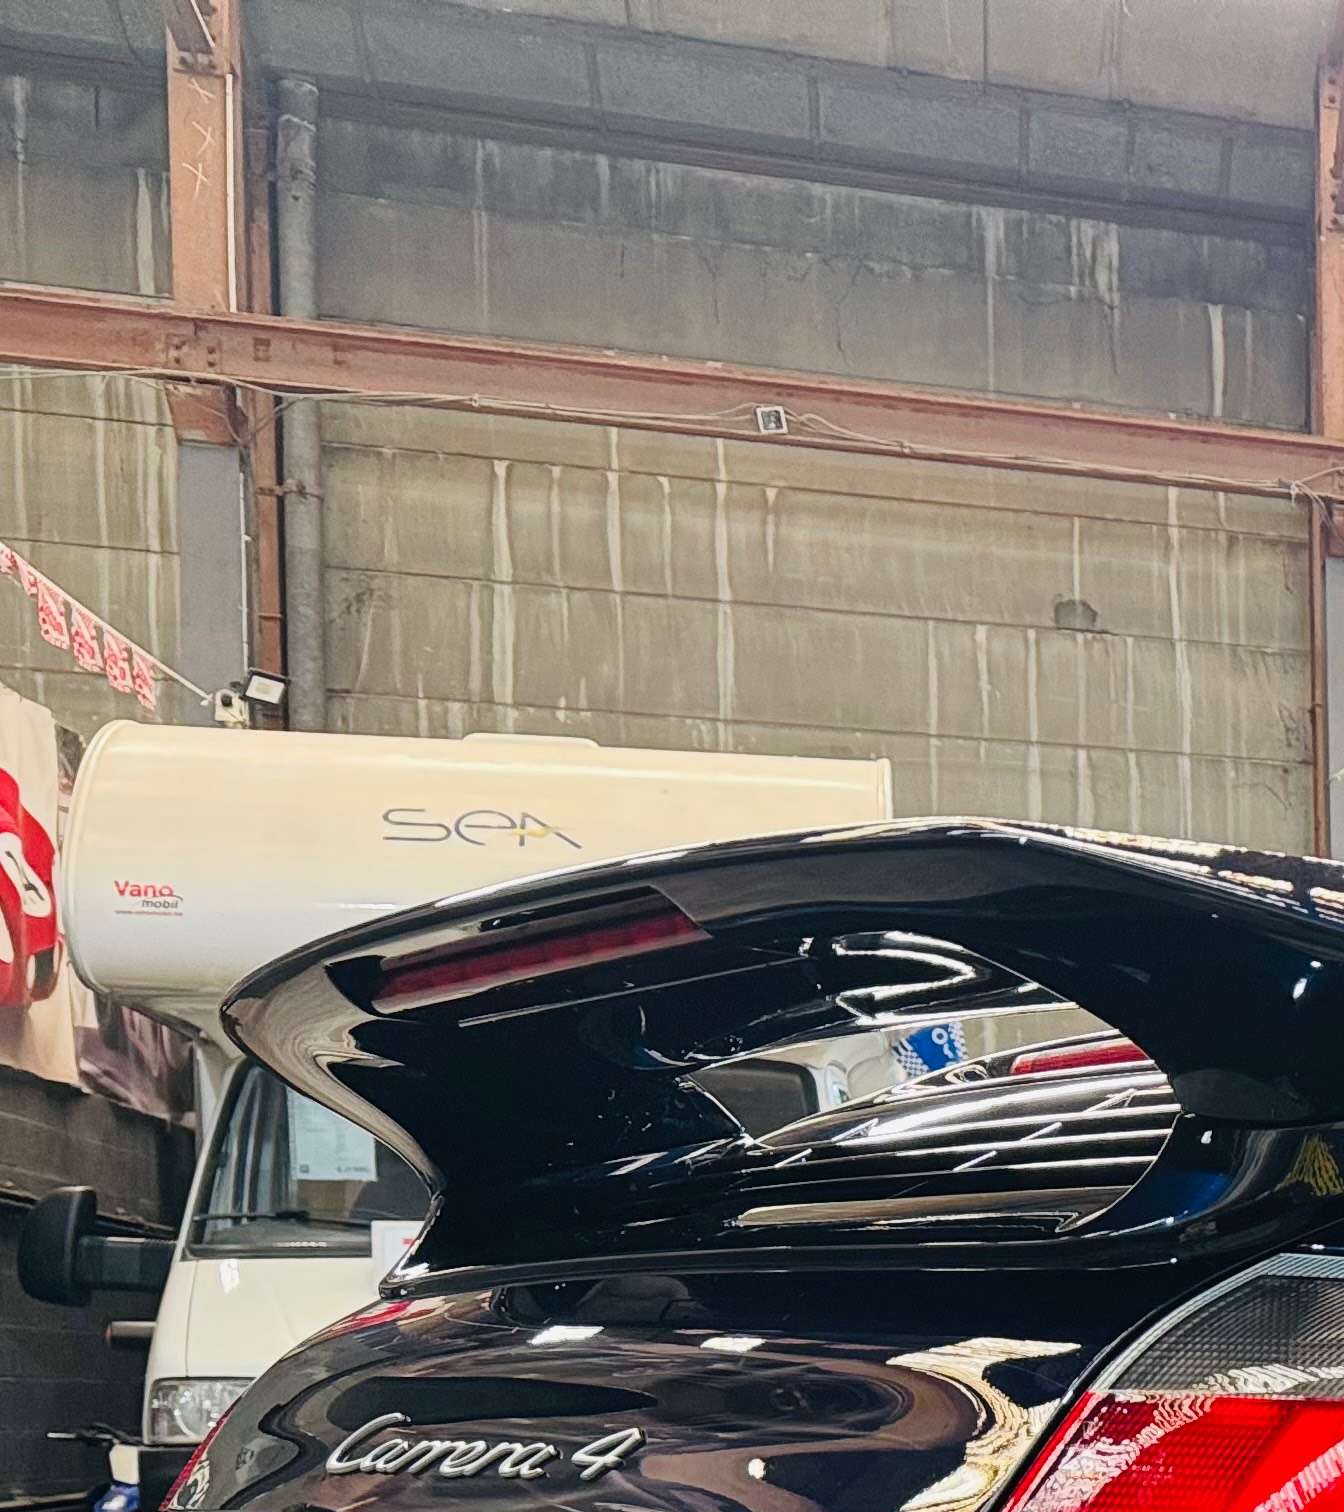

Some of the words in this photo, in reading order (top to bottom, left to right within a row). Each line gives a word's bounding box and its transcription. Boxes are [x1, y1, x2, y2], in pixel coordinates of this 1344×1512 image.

[114, 880, 174, 898] Vano
[141, 899, 179, 909] mobil
[326, 1412, 564, 1479] Carrera
[571, 1427, 648, 1482] 4
